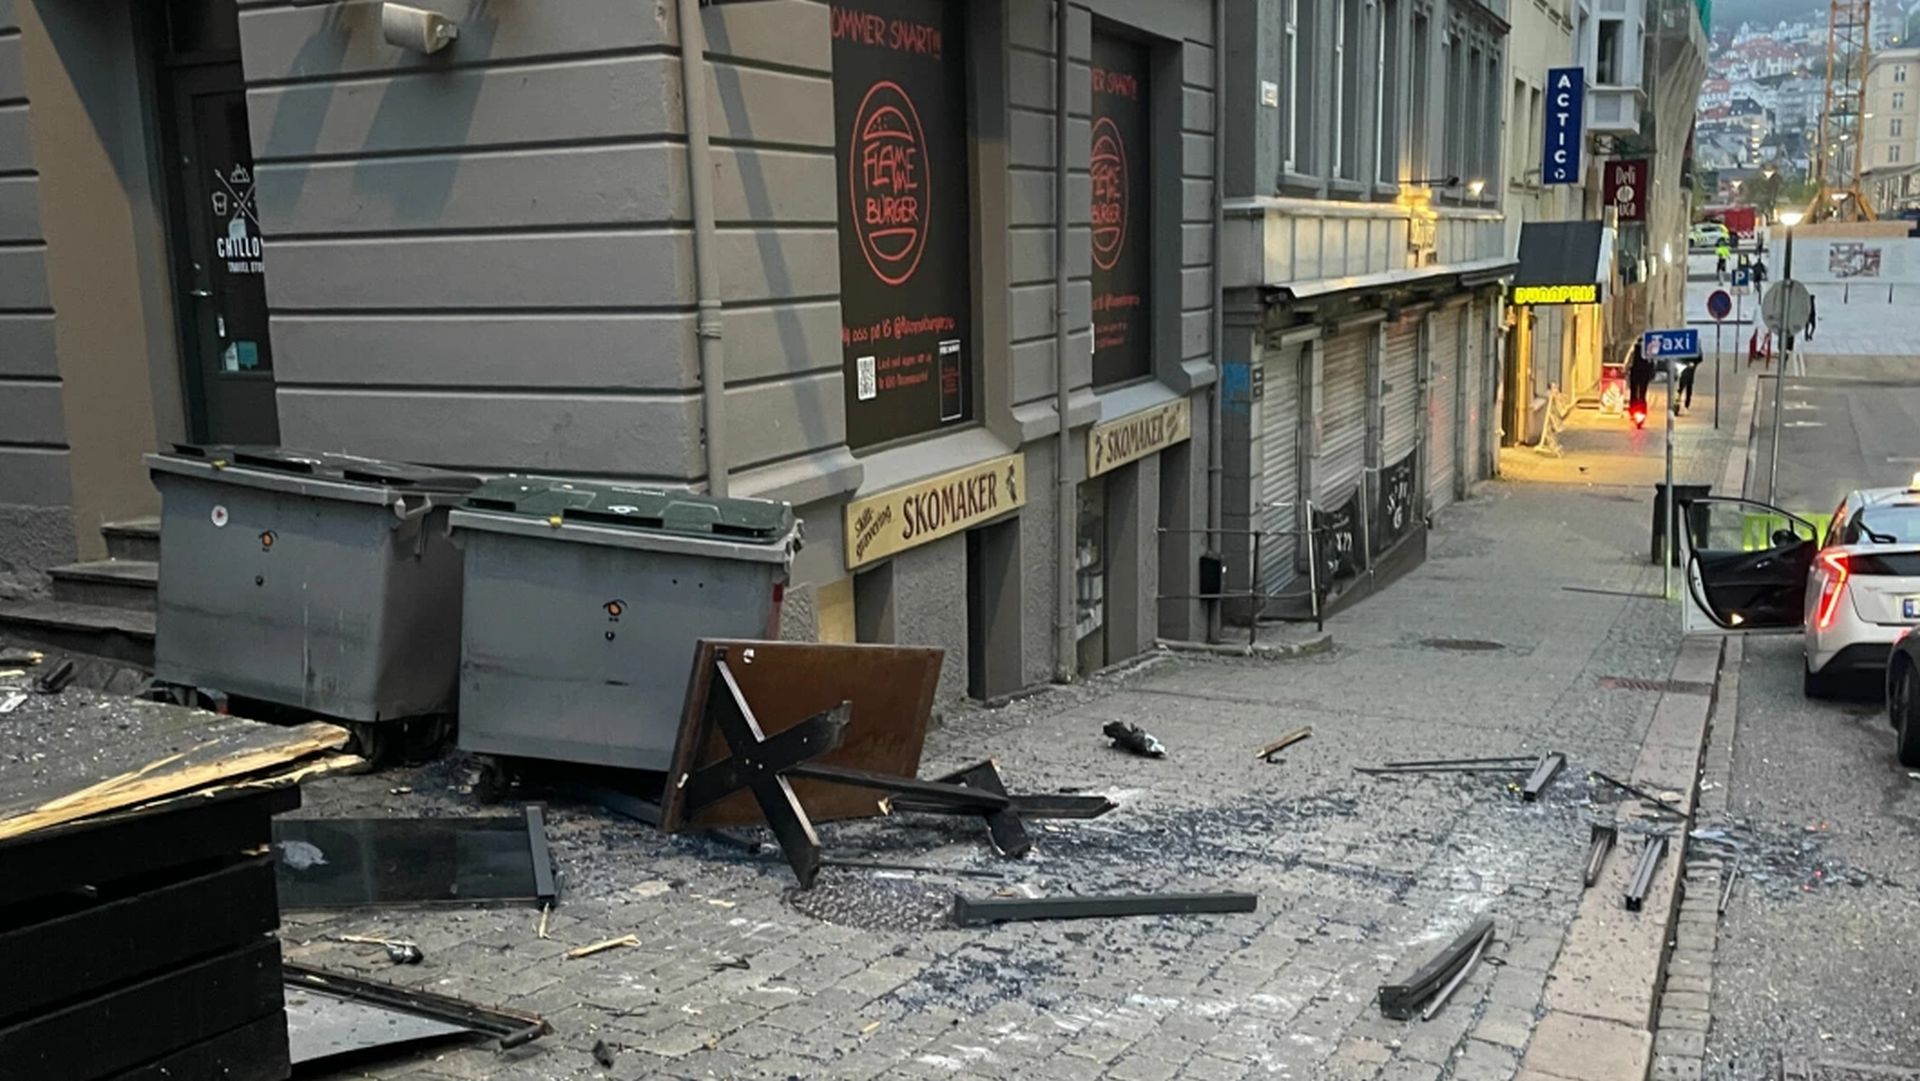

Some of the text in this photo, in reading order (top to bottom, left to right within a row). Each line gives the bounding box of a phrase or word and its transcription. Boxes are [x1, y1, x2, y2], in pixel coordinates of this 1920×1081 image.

[831, 6, 885, 46] OMMER
[1553, 74, 1571, 164] ACTIC
[1615, 165, 1636, 186] Deli
[865, 194, 919, 224] BURGER
[217, 237, 263, 259] CHILLO
[1735, 271, 1745, 285] P
[1651, 333, 1690, 353] Taxi
[1106, 414, 1164, 465] SKOMAKER
[902, 470, 998, 540] SKOMAKER
